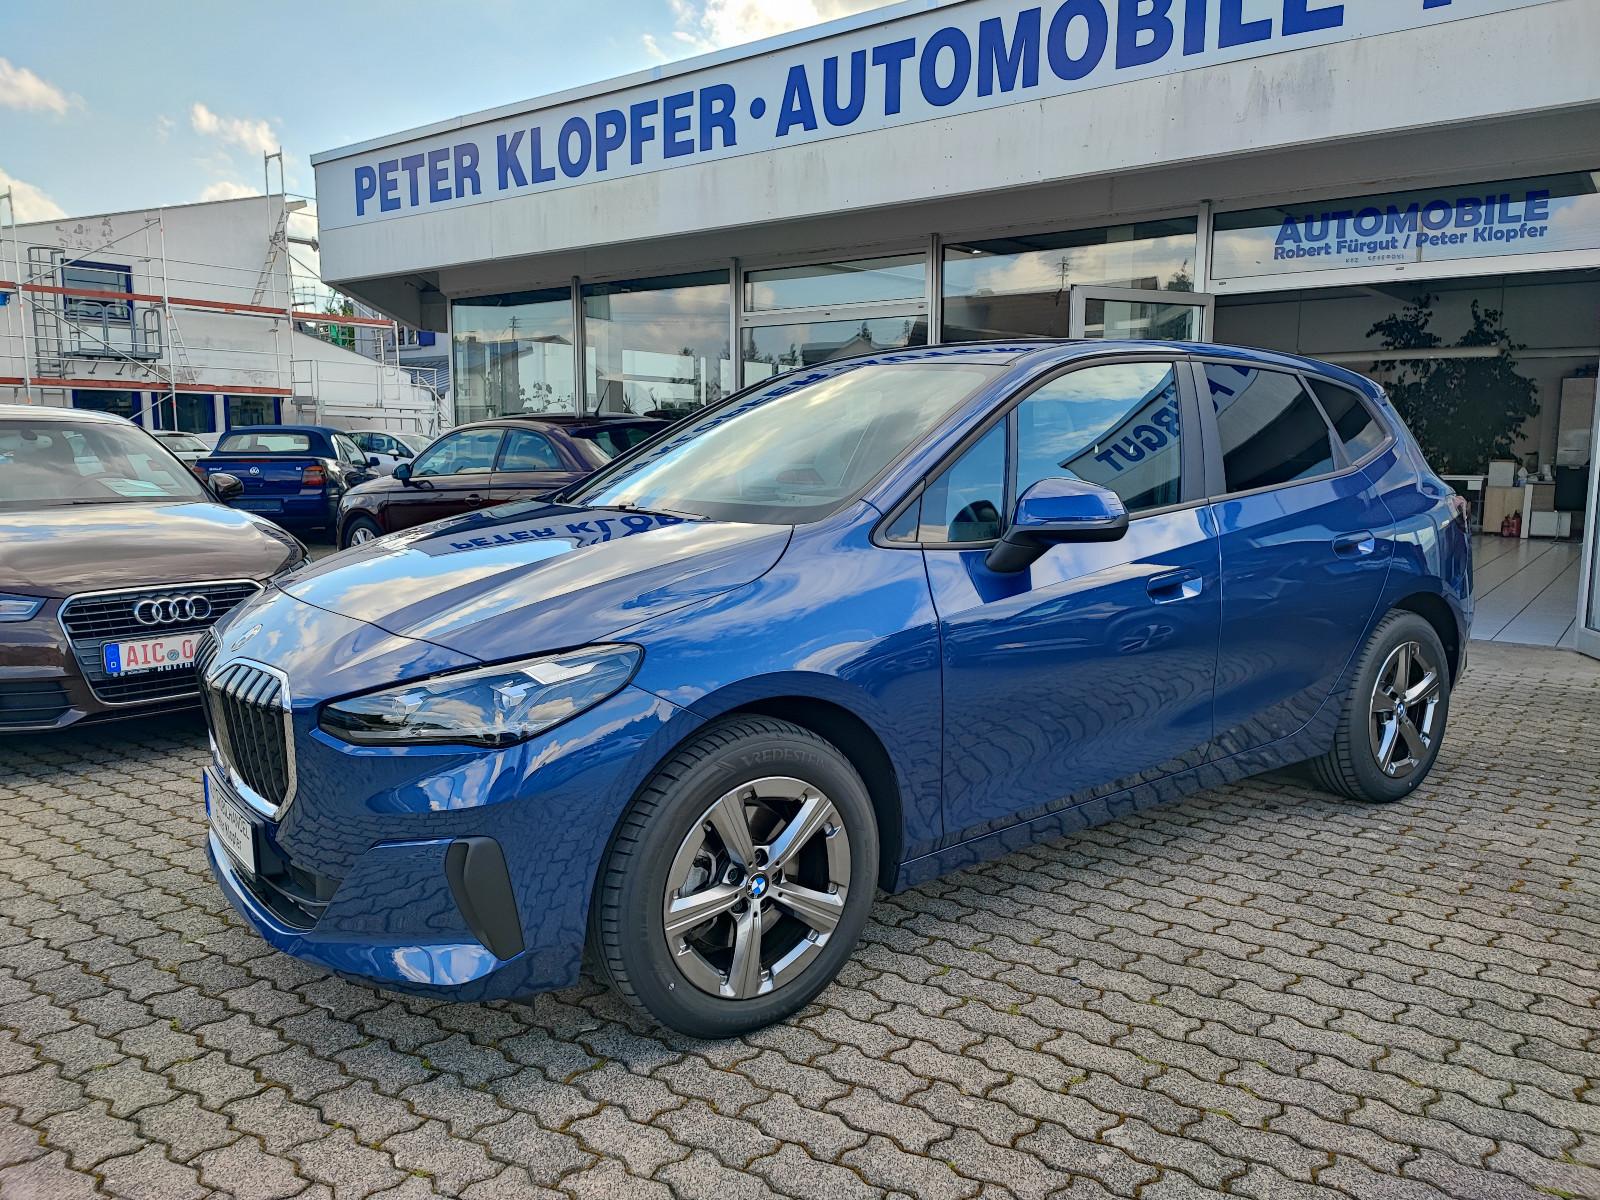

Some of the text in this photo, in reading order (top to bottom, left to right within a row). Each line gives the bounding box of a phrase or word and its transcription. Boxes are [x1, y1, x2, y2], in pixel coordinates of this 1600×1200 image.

[355, 142, 482, 216] PETER
[497, 83, 737, 191] KLOPFER
[1275, 189, 1550, 245] AUTOMOBILE
[1274, 243, 1332, 260] Robert
[1336, 236, 1398, 254] Fürgut
[1416, 231, 1467, 247] Peter
[1473, 223, 1548, 242] Klopfer
[127, 642, 165, 667] AIC
